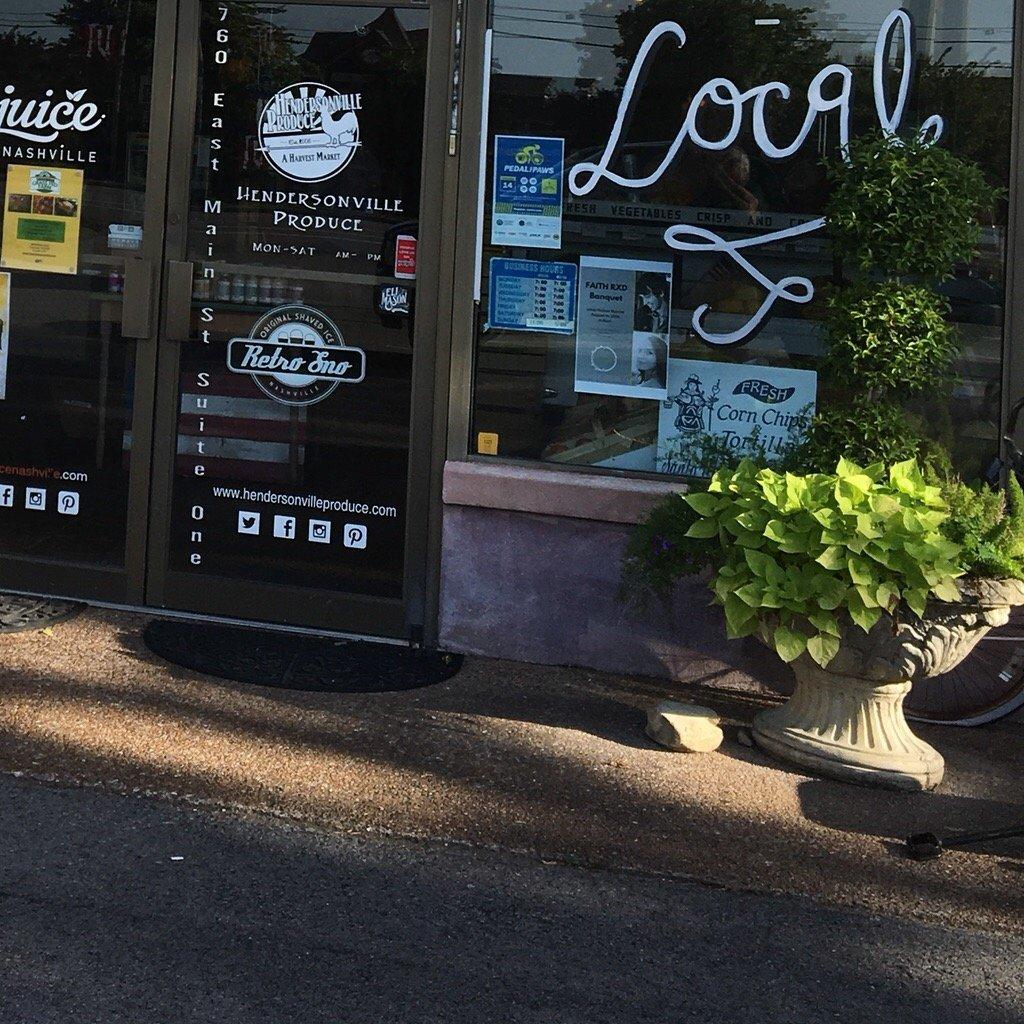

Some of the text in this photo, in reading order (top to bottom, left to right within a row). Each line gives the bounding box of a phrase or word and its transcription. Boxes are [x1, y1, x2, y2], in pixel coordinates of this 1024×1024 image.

[214, 7, 228, 65] 760
[568, 8, 944, 197] Local
[211, 92, 225, 172] East
[266, 109, 316, 132] PRODUCE
[2, 144, 97, 163] NASHVILLE
[282, 151, 341, 163] A HARVEST MARKET
[236, 186, 404, 213] HENDERSONVILLE
[273, 210, 364, 232] PRODUCE
[565, 202, 597, 215] RESH
[611, 205, 682, 220] VEGETABLES
[697, 211, 731, 224] CRISP
[203, 199, 222, 279] Main
[252, 242, 316, 257] MON-SAT
[367, 253, 382, 262] PM
[504, 262, 564, 275] BUSINESS HOURS
[585, 281, 609, 291] FAITH
[589, 292, 623, 303] Banquet
[382, 291, 408, 311] MASON
[200, 307, 214, 345] St
[260, 312, 335, 344] ORIGINAL SHAVED ICE
[241, 344, 353, 375] Retro Sno
[740, 381, 788, 401] FRESH
[194, 372, 211, 477] Suite
[717, 405, 809, 432] Corn Chips
[212, 486, 398, 518] www.hendersonvilleproduce.com
